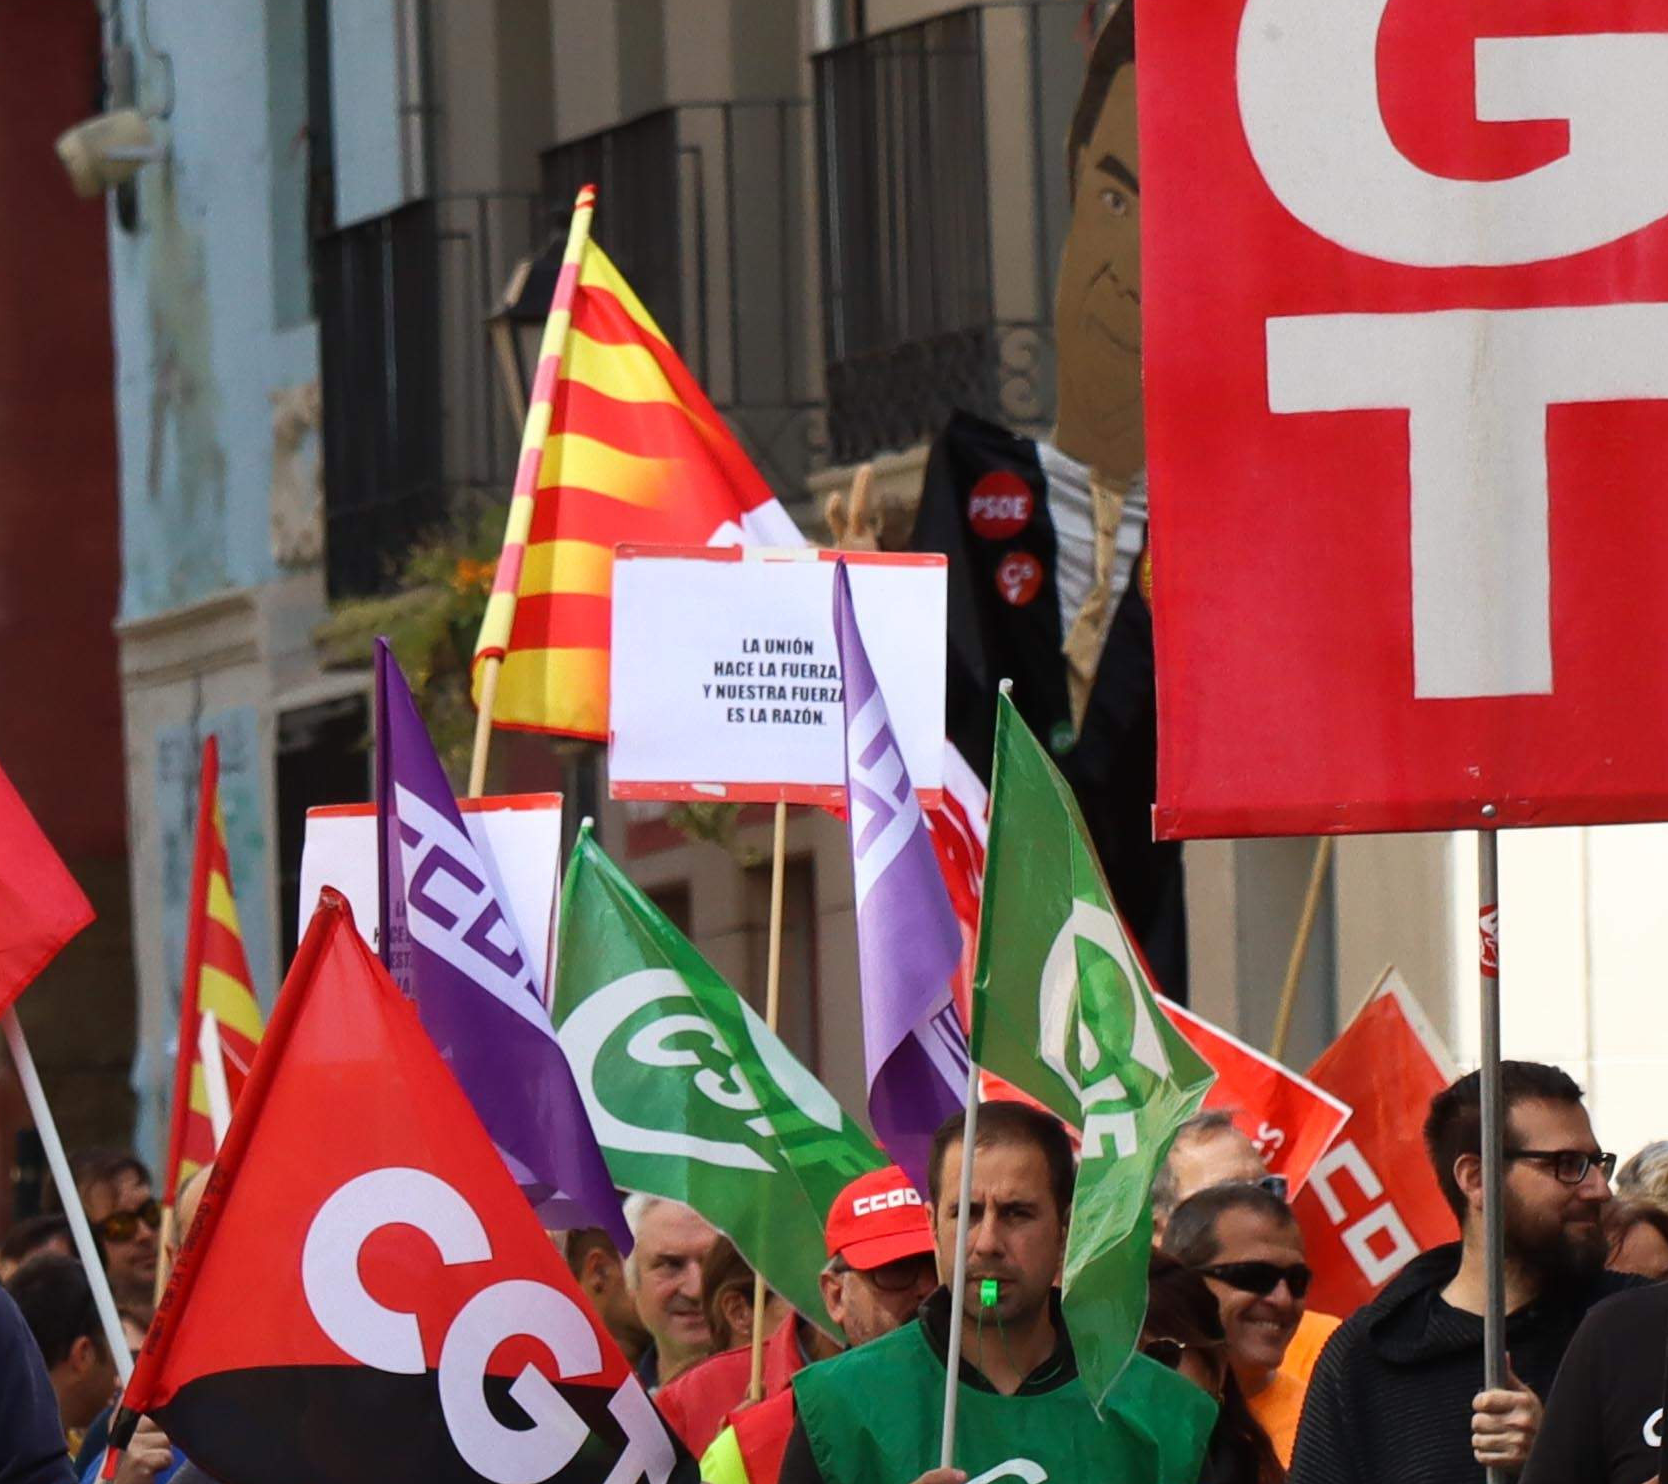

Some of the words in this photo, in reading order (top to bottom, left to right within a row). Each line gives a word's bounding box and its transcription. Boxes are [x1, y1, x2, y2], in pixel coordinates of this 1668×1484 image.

[968, 496, 1029, 521] PSOE
[742, 638, 760, 654] LA
[764, 636, 814, 656] UNIÓN
[714, 661, 755, 677] HACE
[759, 661, 777, 678] LA
[702, 684, 712, 700] Y
[715, 684, 787, 701] NUESTRA
[726, 707, 745, 723] ES
[749, 707, 768, 724] LA
[853, 1188, 922, 1216] CCOO
